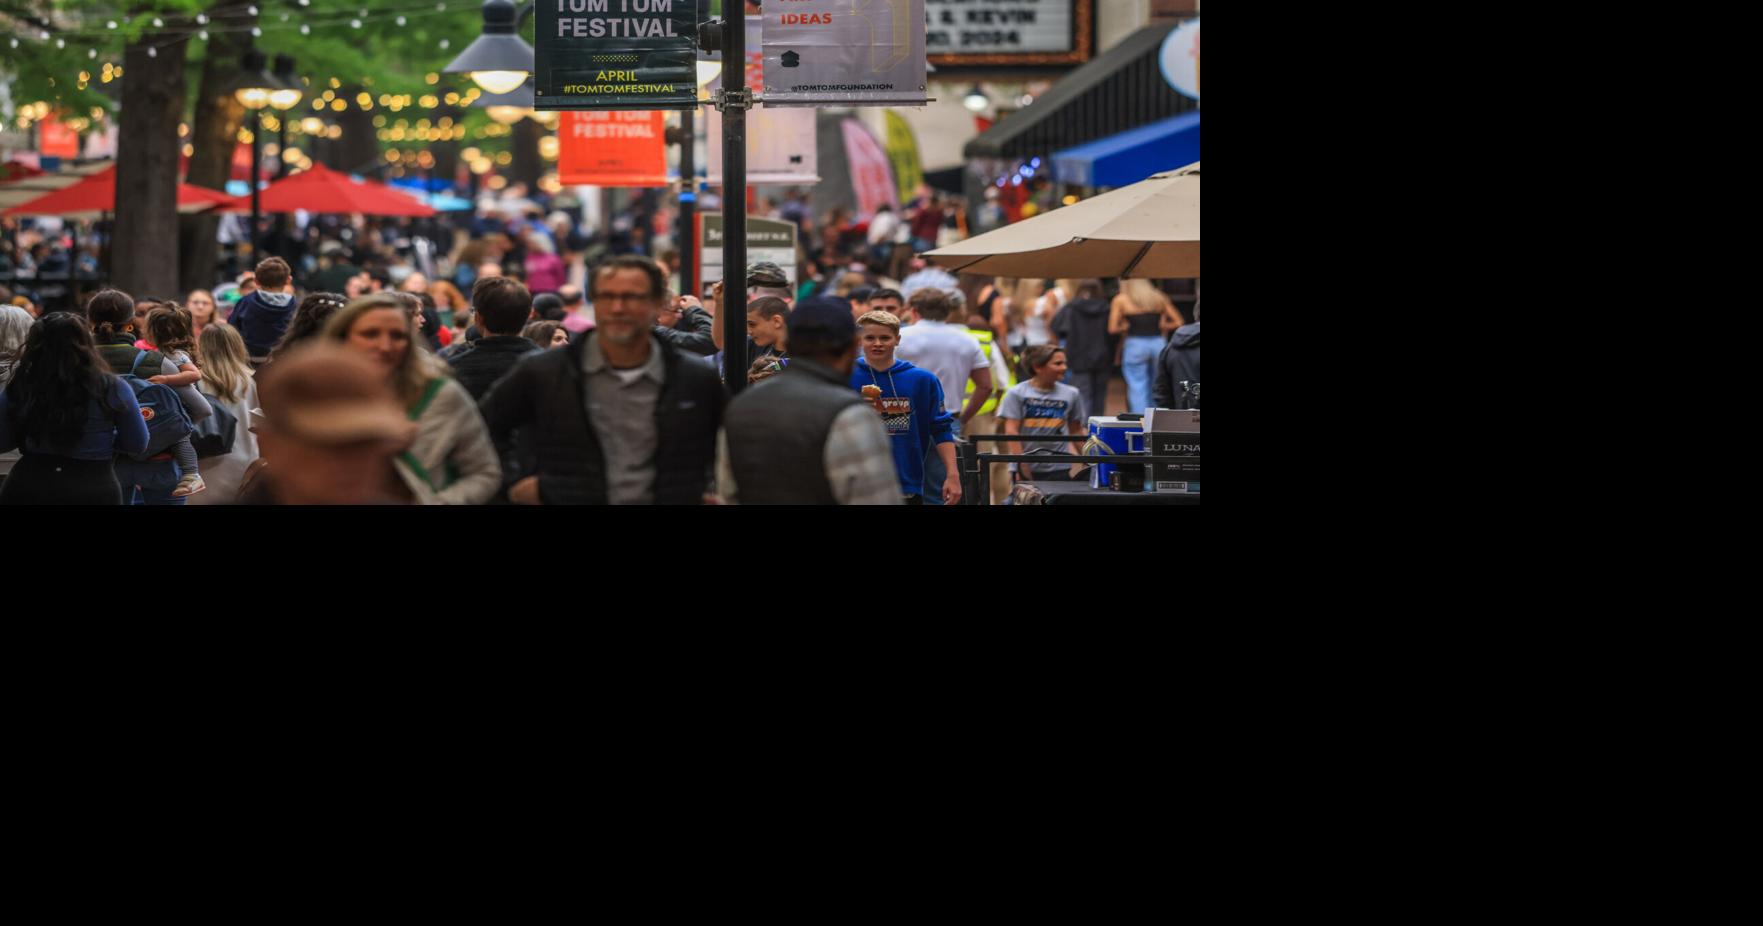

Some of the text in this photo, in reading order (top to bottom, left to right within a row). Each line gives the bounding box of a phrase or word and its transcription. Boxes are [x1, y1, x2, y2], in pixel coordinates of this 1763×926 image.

[781, 13, 832, 25] IDEAS
[558, 18, 678, 37] FESTIVAL
[596, 70, 638, 82] APRIL
[564, 84, 676, 94] #TOMTOMFESTIVAL
[791, 83, 893, 93] @TOMTOMFOUNDATION
[573, 123, 655, 138] FESTIVAL
